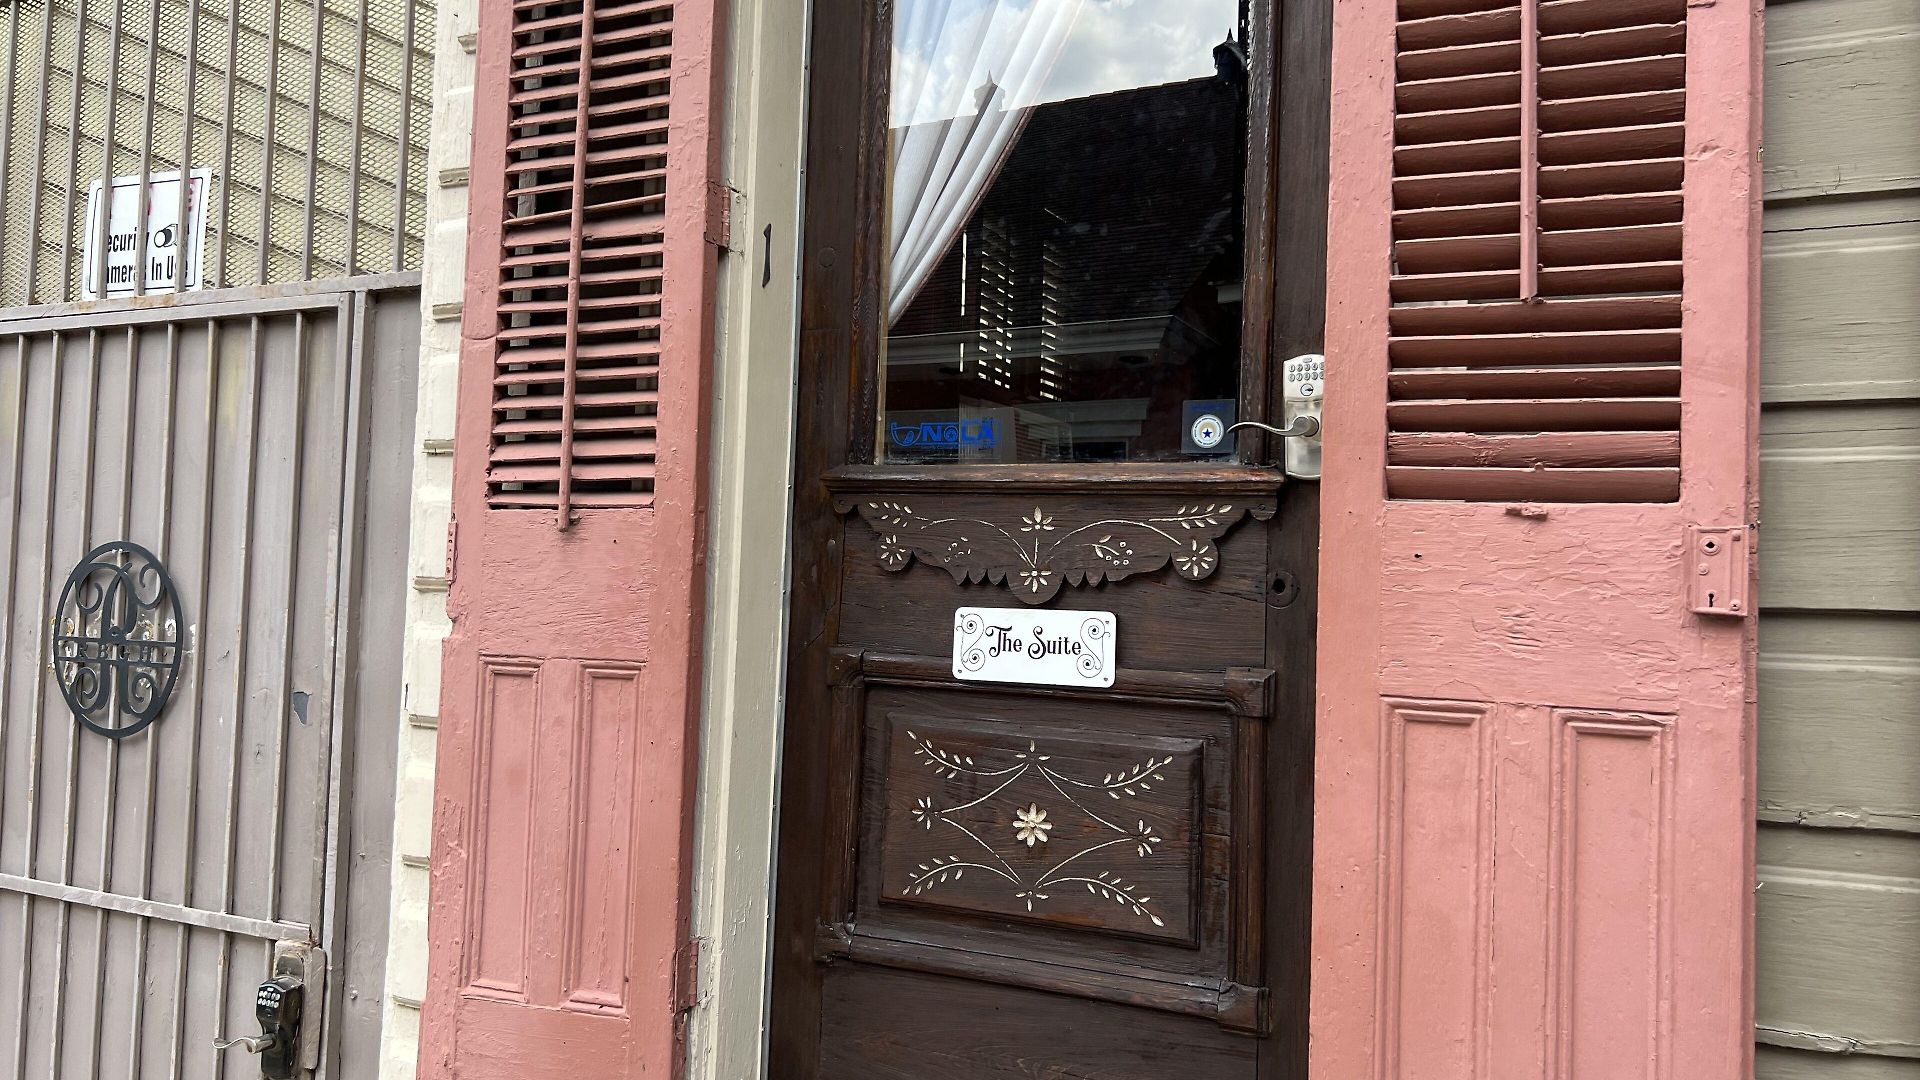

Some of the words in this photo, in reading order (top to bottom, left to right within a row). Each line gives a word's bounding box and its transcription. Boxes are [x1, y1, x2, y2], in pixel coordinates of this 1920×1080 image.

[151, 256, 162, 281] In
[921, 422, 994, 443] NOLA
[985, 625, 1023, 658] The
[1028, 625, 1082, 660] Suite
